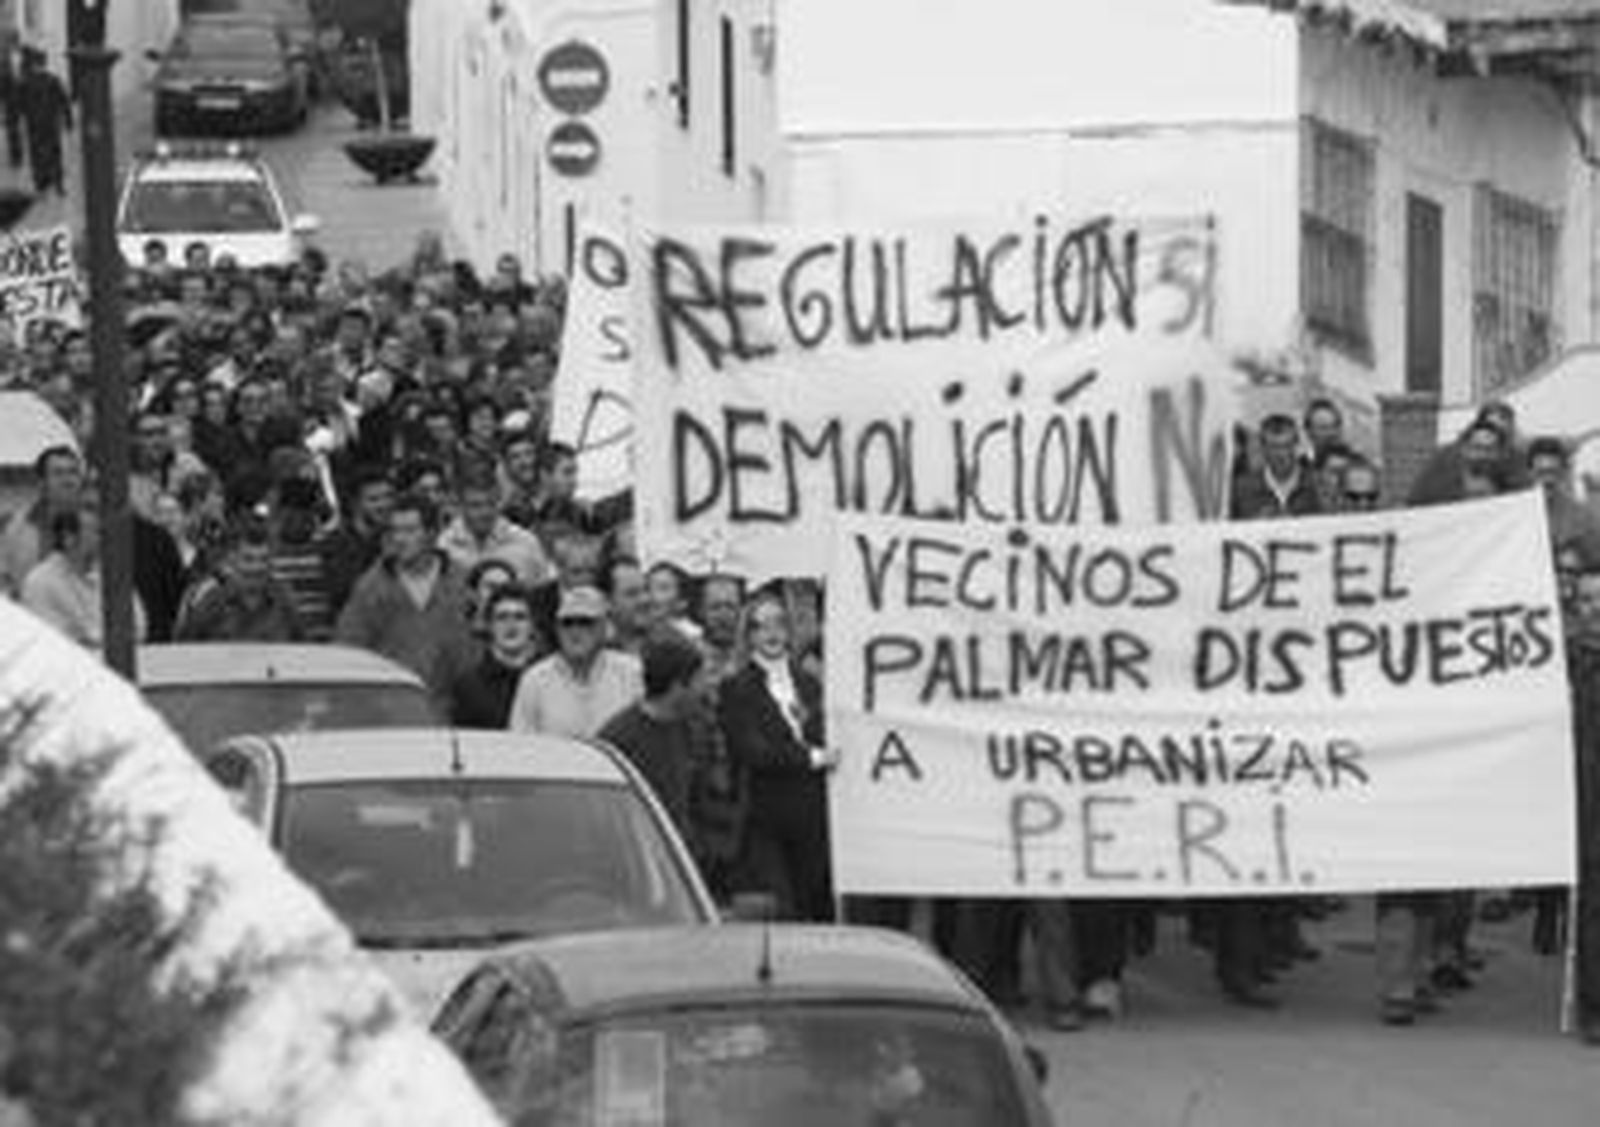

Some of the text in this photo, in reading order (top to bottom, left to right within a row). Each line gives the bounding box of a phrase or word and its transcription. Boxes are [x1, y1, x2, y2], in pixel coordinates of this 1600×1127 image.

[1219, 537, 1318, 613] DE
[1331, 532, 1410, 605] EL
[862, 605, 1555, 712] PALMAR DISPUESTOS
[870, 729, 922, 783] A
